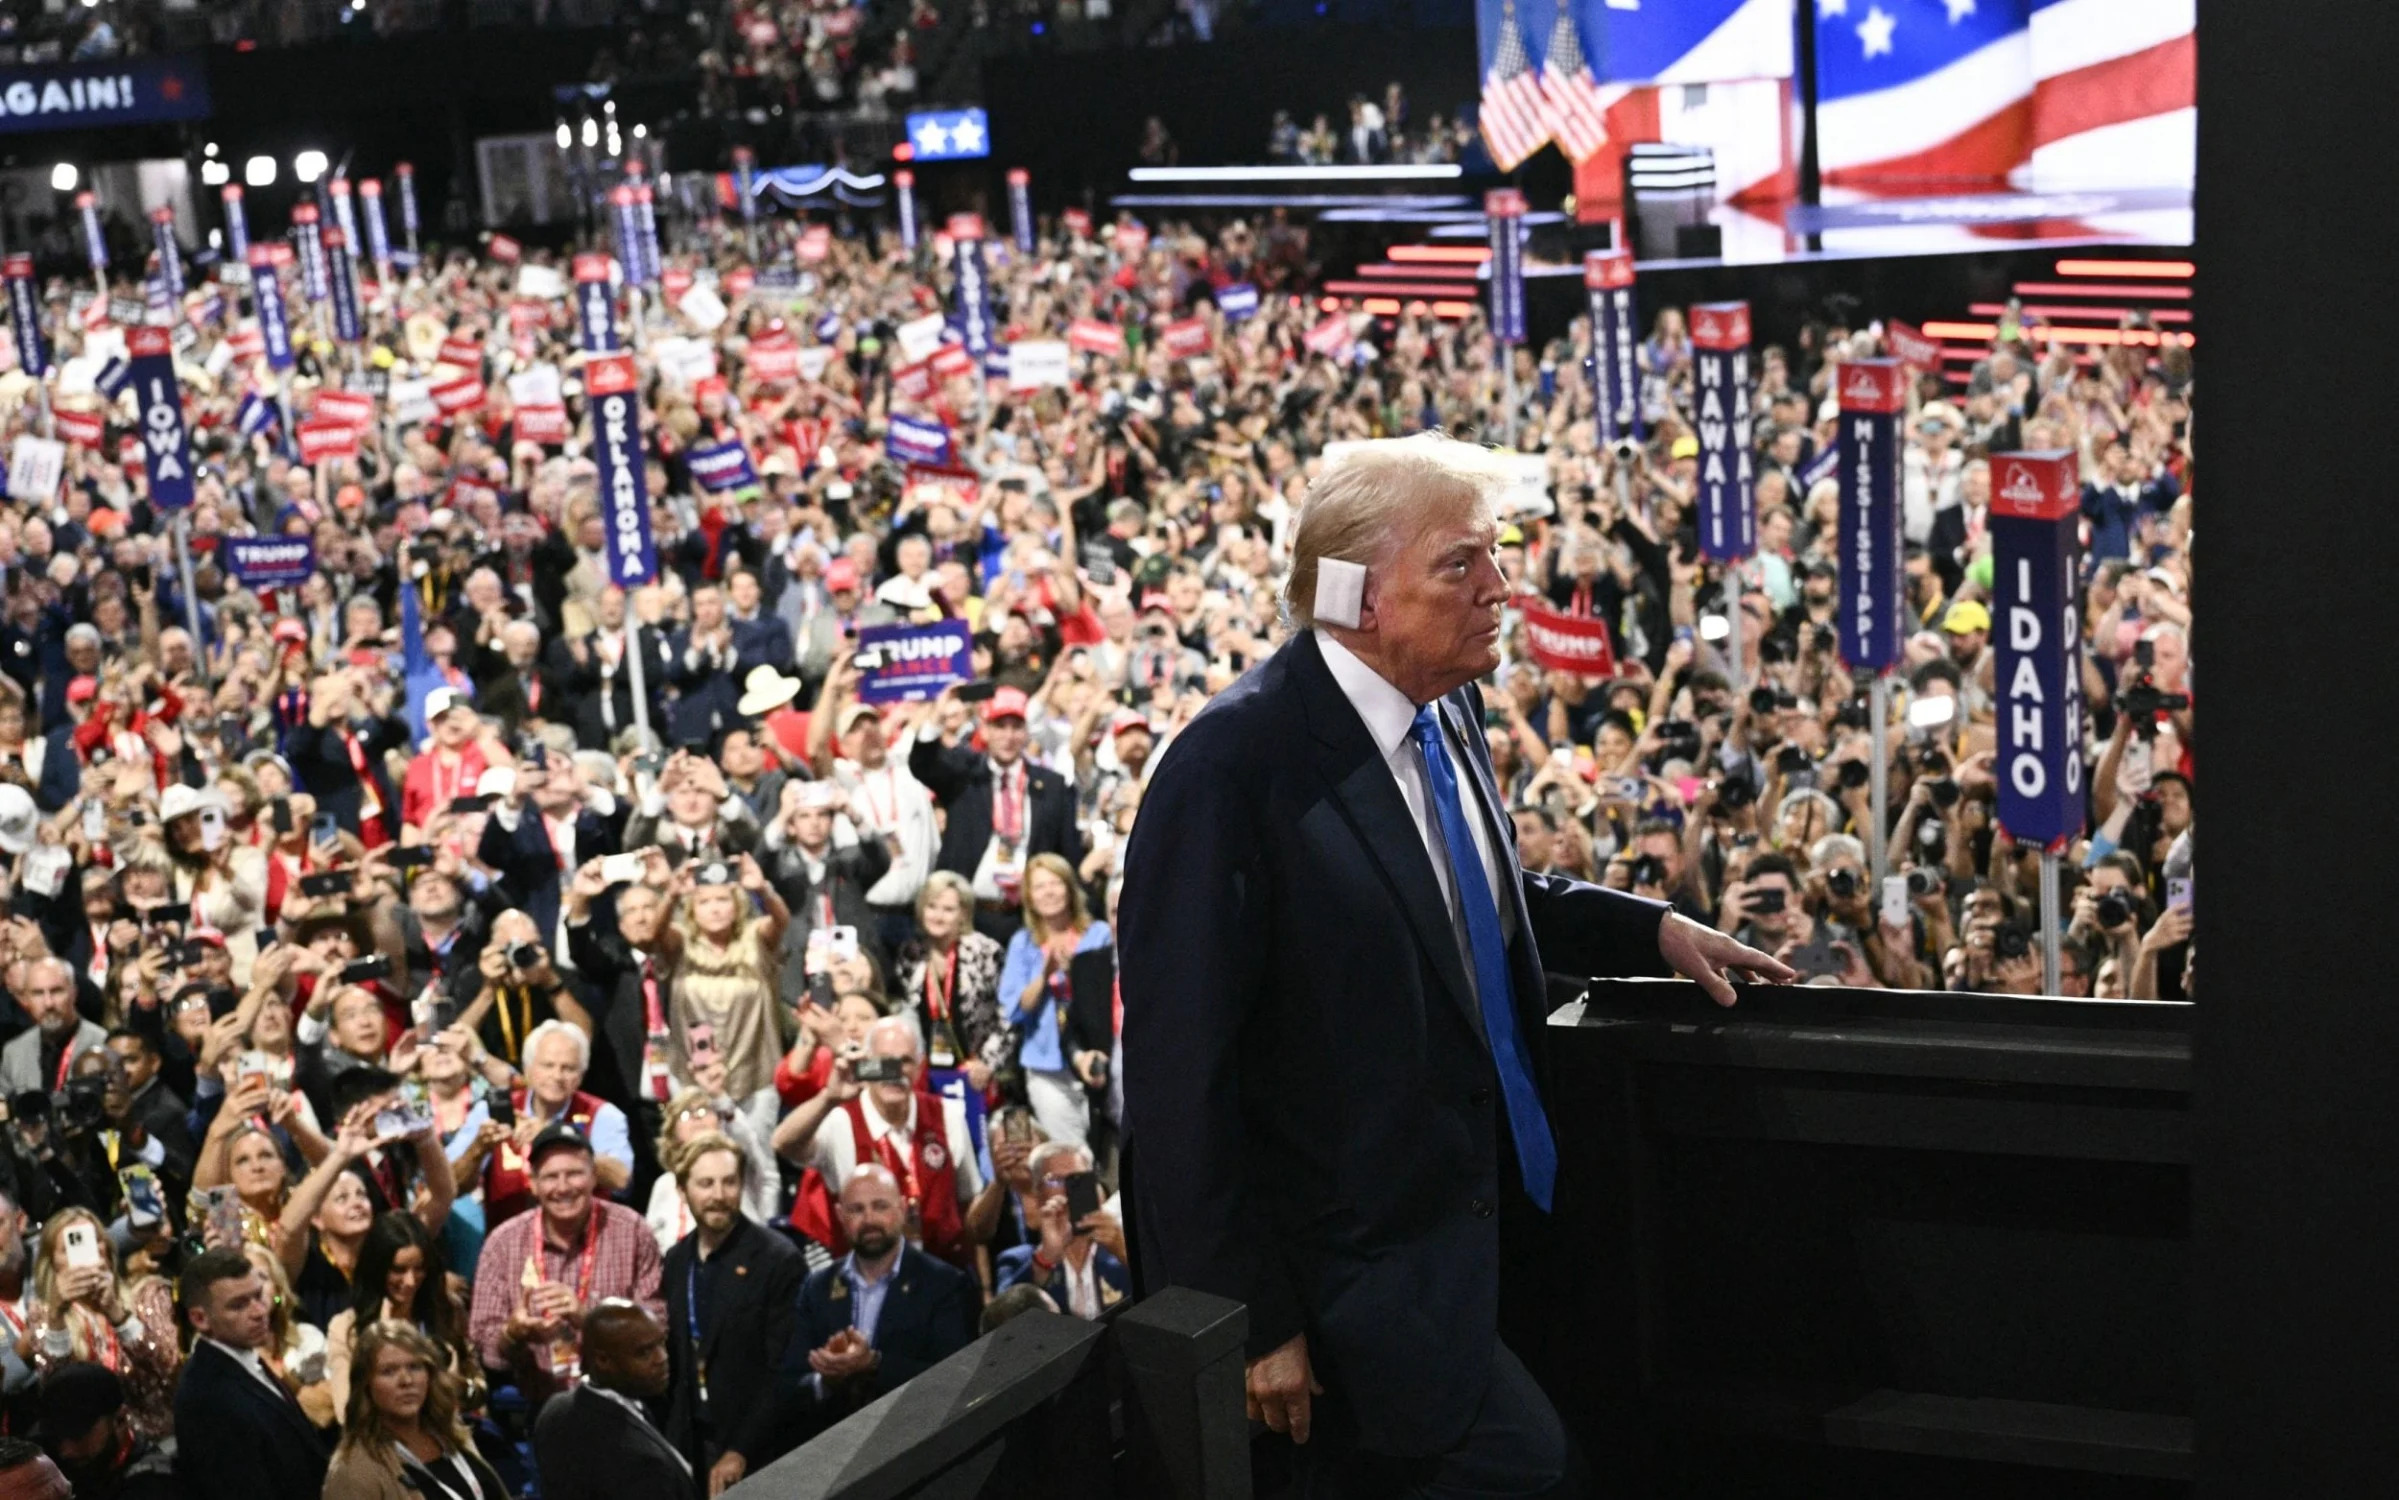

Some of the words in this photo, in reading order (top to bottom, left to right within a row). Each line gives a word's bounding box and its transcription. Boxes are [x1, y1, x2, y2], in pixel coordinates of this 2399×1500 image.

[0, 74, 135, 117] GAIN!
[147, 378, 184, 482] IOWA
[603, 395, 645, 577] OKLAHOMA
[1700, 355, 1727, 546] HAWAII
[1733, 352, 1752, 544] HAWAII
[234, 543, 309, 564] TRUMP
[1854, 418, 1873, 659] MISSISSIPPI
[1527, 620, 1603, 653] TRUMP
[2010, 558, 2046, 799] IDAHO
[2064, 554, 2080, 793] IDAHO
